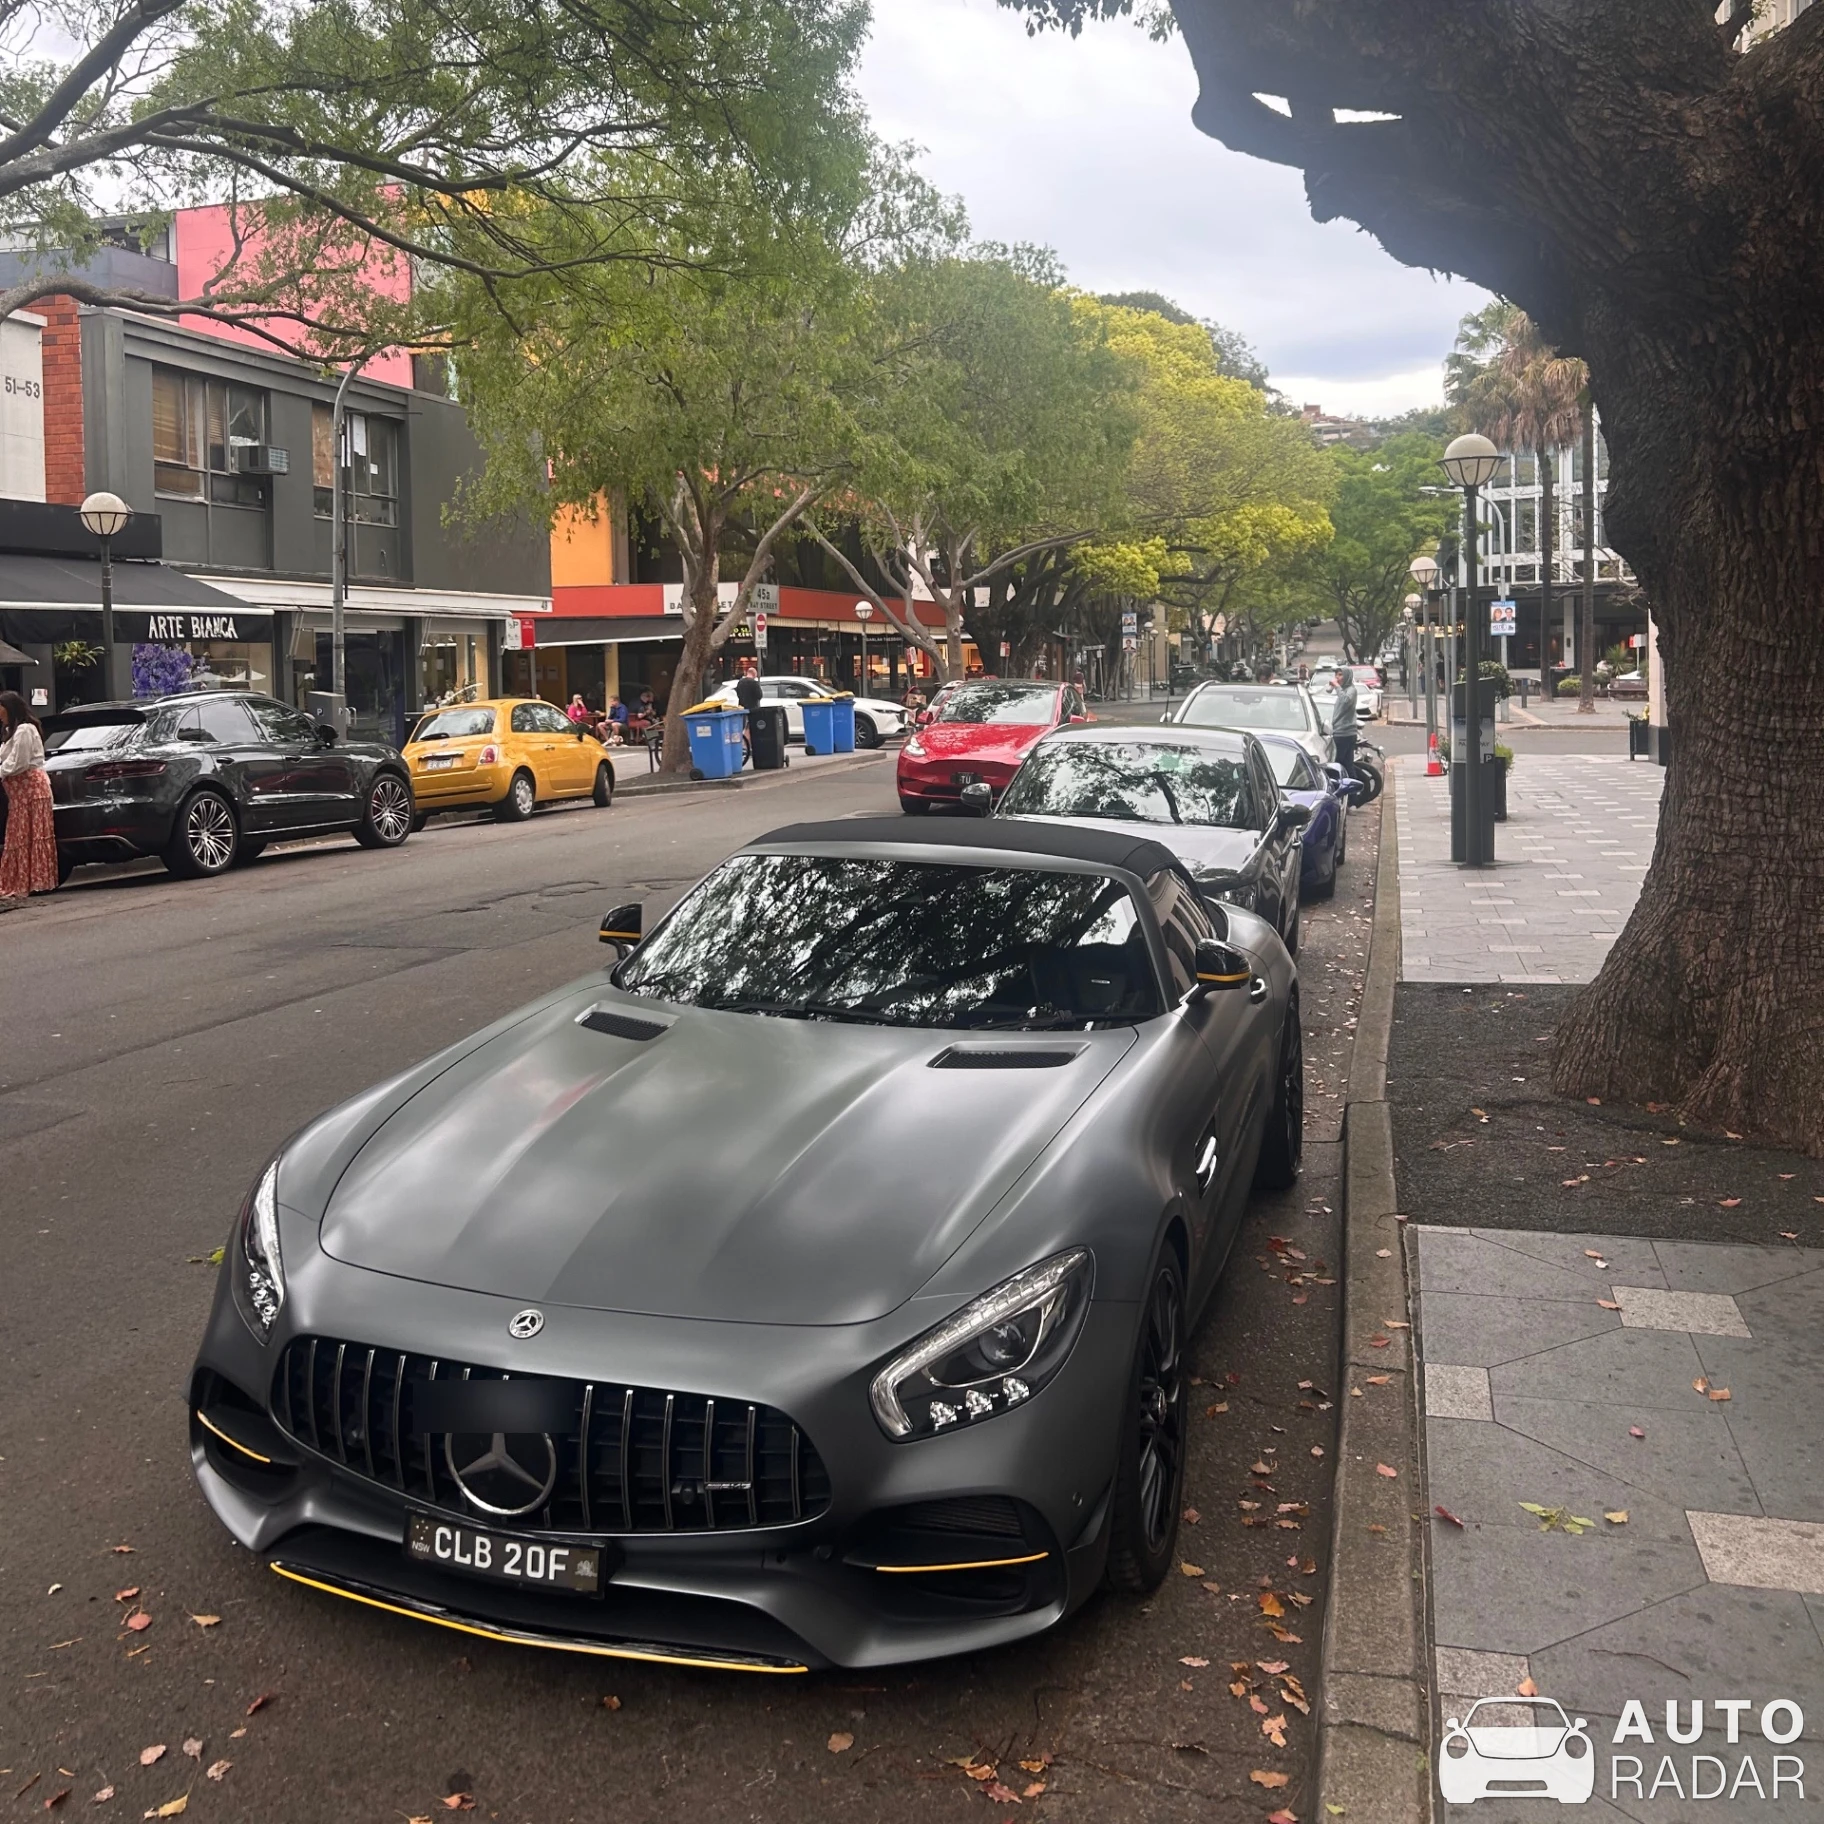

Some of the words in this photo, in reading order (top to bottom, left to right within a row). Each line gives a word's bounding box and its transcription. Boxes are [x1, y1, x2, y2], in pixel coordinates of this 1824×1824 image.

[5, 376, 41, 399] 51-53
[757, 588, 770, 600] 45a
[148, 615, 185, 639] ARTE
[191, 615, 239, 639] BIANCA
[1485, 754, 1493, 763] P
[411, 1540, 430, 1553] NSW
[434, 1526, 493, 1569] CLB
[503, 1542, 570, 1581] 20F
